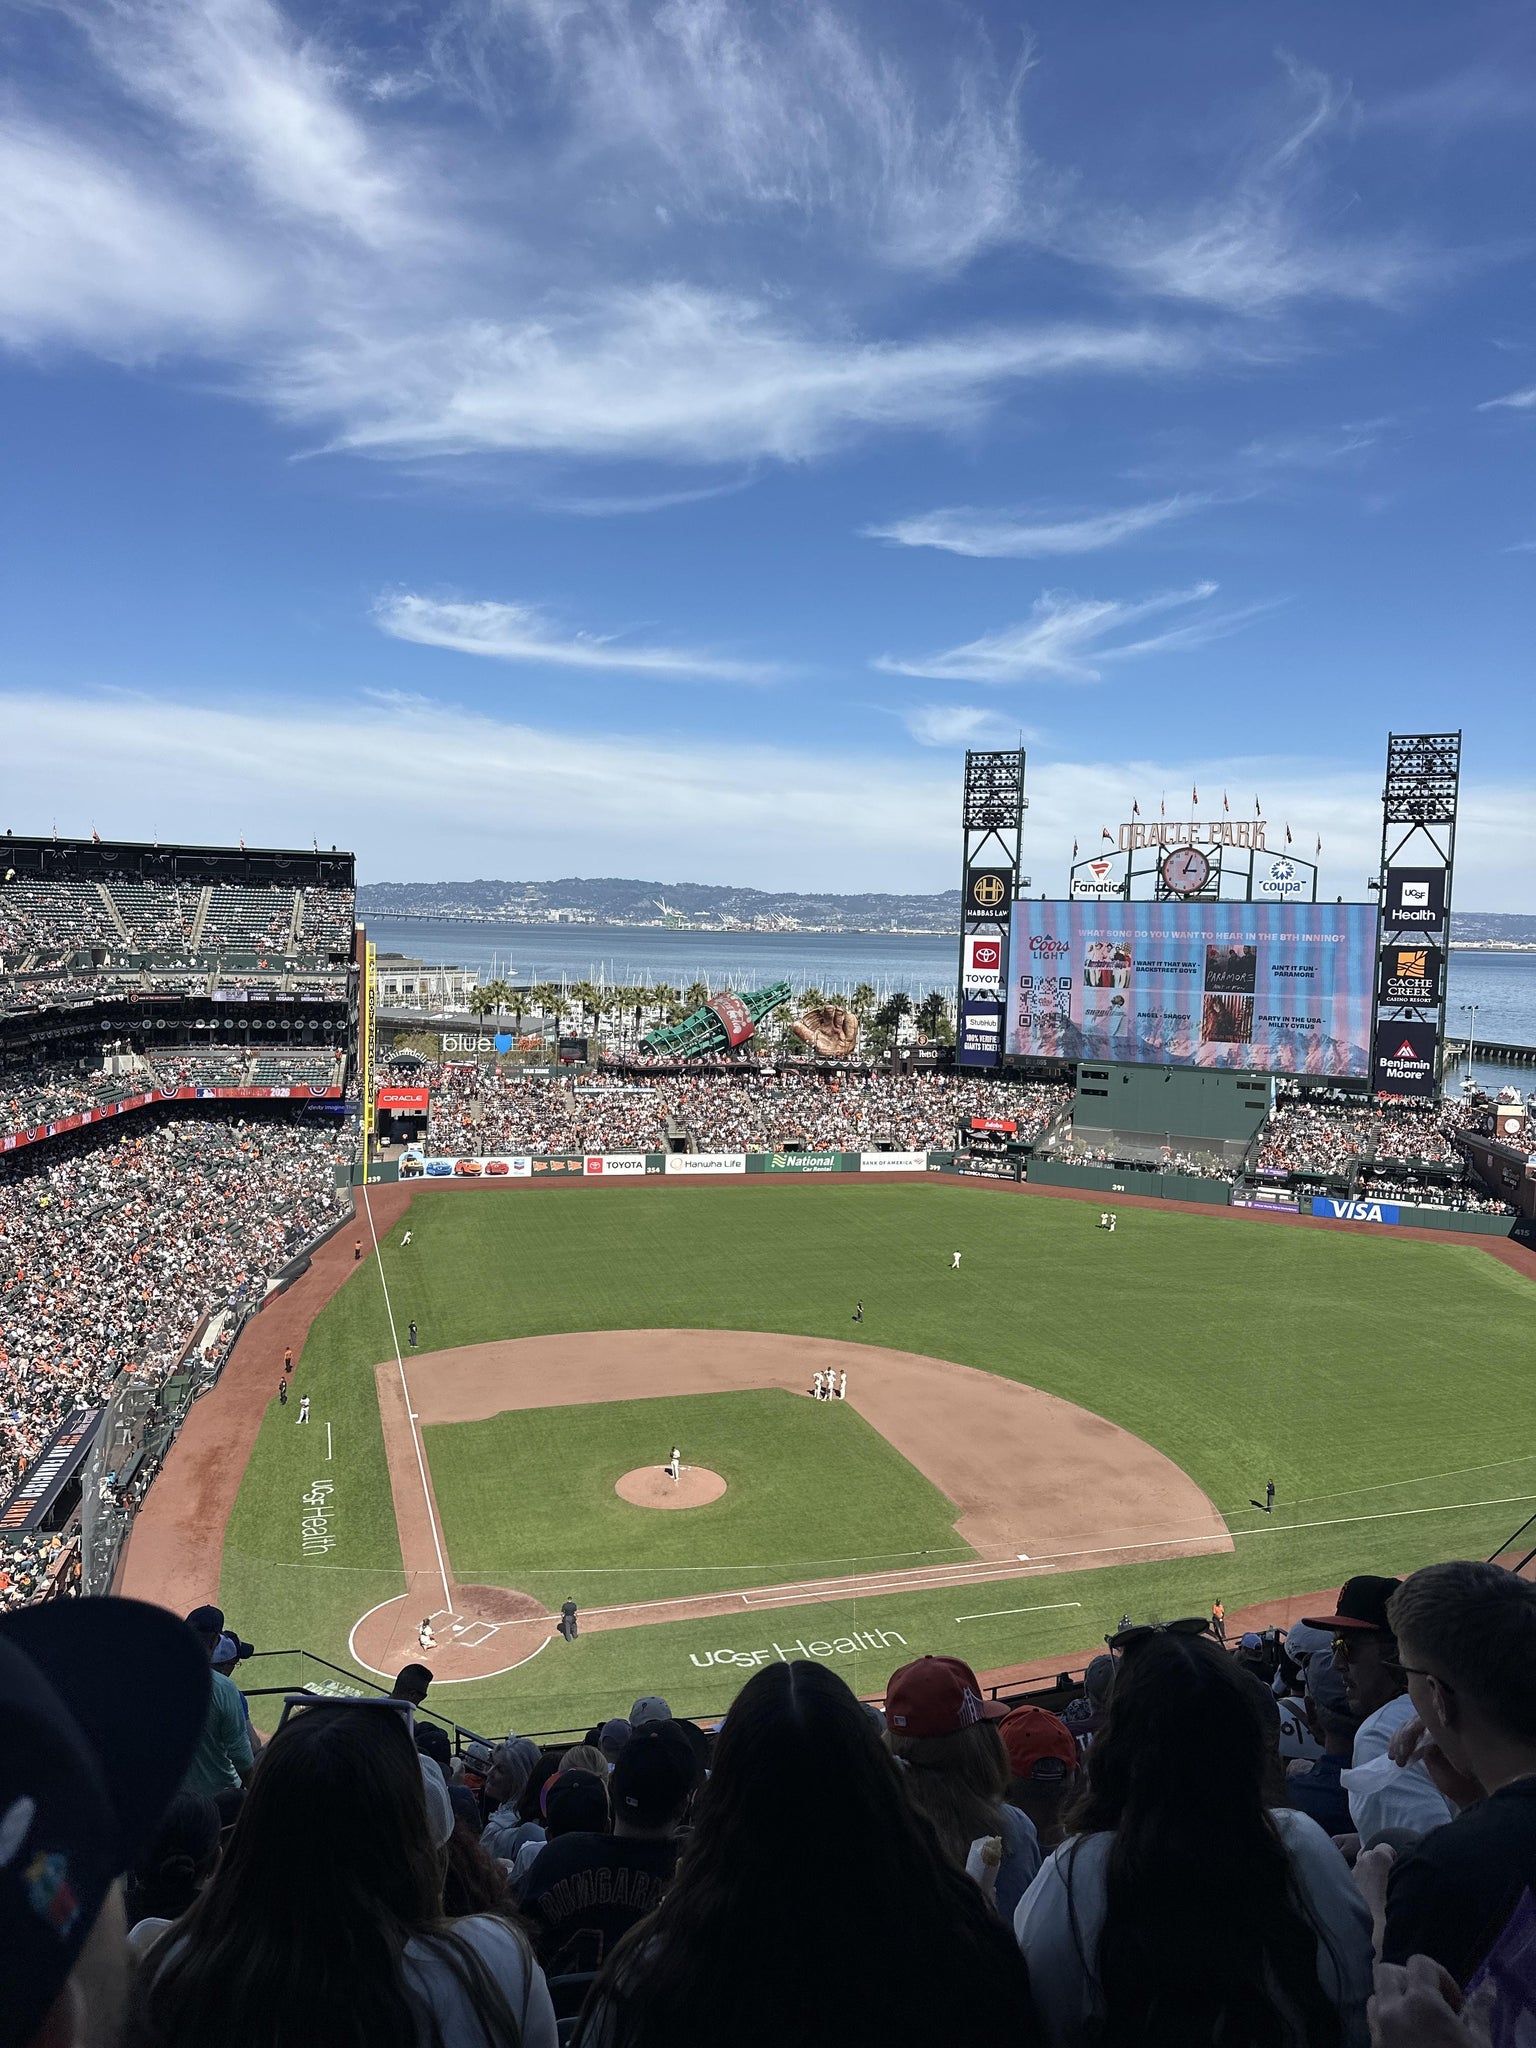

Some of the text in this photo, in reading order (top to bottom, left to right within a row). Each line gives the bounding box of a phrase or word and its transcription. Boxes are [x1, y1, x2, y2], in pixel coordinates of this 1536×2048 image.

[1118, 821, 1267, 852] ORACLE PARK
[1073, 881, 1125, 893] Fanatics
[1262, 882, 1301, 894] coupa
[1405, 889, 1425, 899] UCSF
[967, 909, 994, 917] HABBAS
[1392, 909, 1436, 921] Health
[1078, 929, 1104, 938] WHAT
[1106, 930, 1132, 938] SONG
[1134, 930, 1148, 938] DO
[1171, 931, 1200, 939] WANT
[1201, 932, 1213, 940] TO
[1216, 932, 1243, 940] HEAR
[1245, 933, 1256, 941] IN
[1258, 933, 1278, 941] THE
[1302, 934, 1346, 943] INNING?
[1029, 935, 1070, 952] Coors
[1033, 952, 1064, 960] LIGHT
[966, 974, 1004, 984] TOYOTA
[1388, 978, 1433, 988] CACHE
[1388, 987, 1431, 997] CREEK
[970, 1018, 996, 1026] StubHub
[442, 1034, 491, 1052] blue
[966, 1034, 978, 1042] 100%
[964, 1042, 981, 1050] GIANTS
[382, 1047, 428, 1064] Ghirardelli
[1380, 1058, 1430, 1071] Benjamin
[1386, 1068, 1422, 1079] Moore
[270, 1088, 290, 1097] 2026
[1378, 1090, 1428, 1103] Coors LIGHT
[606, 1161, 642, 1169] TOYOTA
[685, 1160, 742, 1168] Hanwha Life
[787, 1156, 835, 1167] National
[1112, 1184, 1124, 1192] 391
[1368, 1190, 1406, 1201] WELCOME
[1414, 1194, 1422, 1202] TO
[1430, 1196, 1444, 1204] THE
[1328, 1200, 1383, 1222] VISA
[1514, 1228, 1530, 1236] 415
[48, 1445, 76, 1458] SAN
[18, 1459, 67, 1498] FRANCISCO
[0, 1500, 38, 1528] GIANTS
[301, 1479, 337, 1556] UCSF Health
[689, 1628, 908, 1667] UCSF Health
